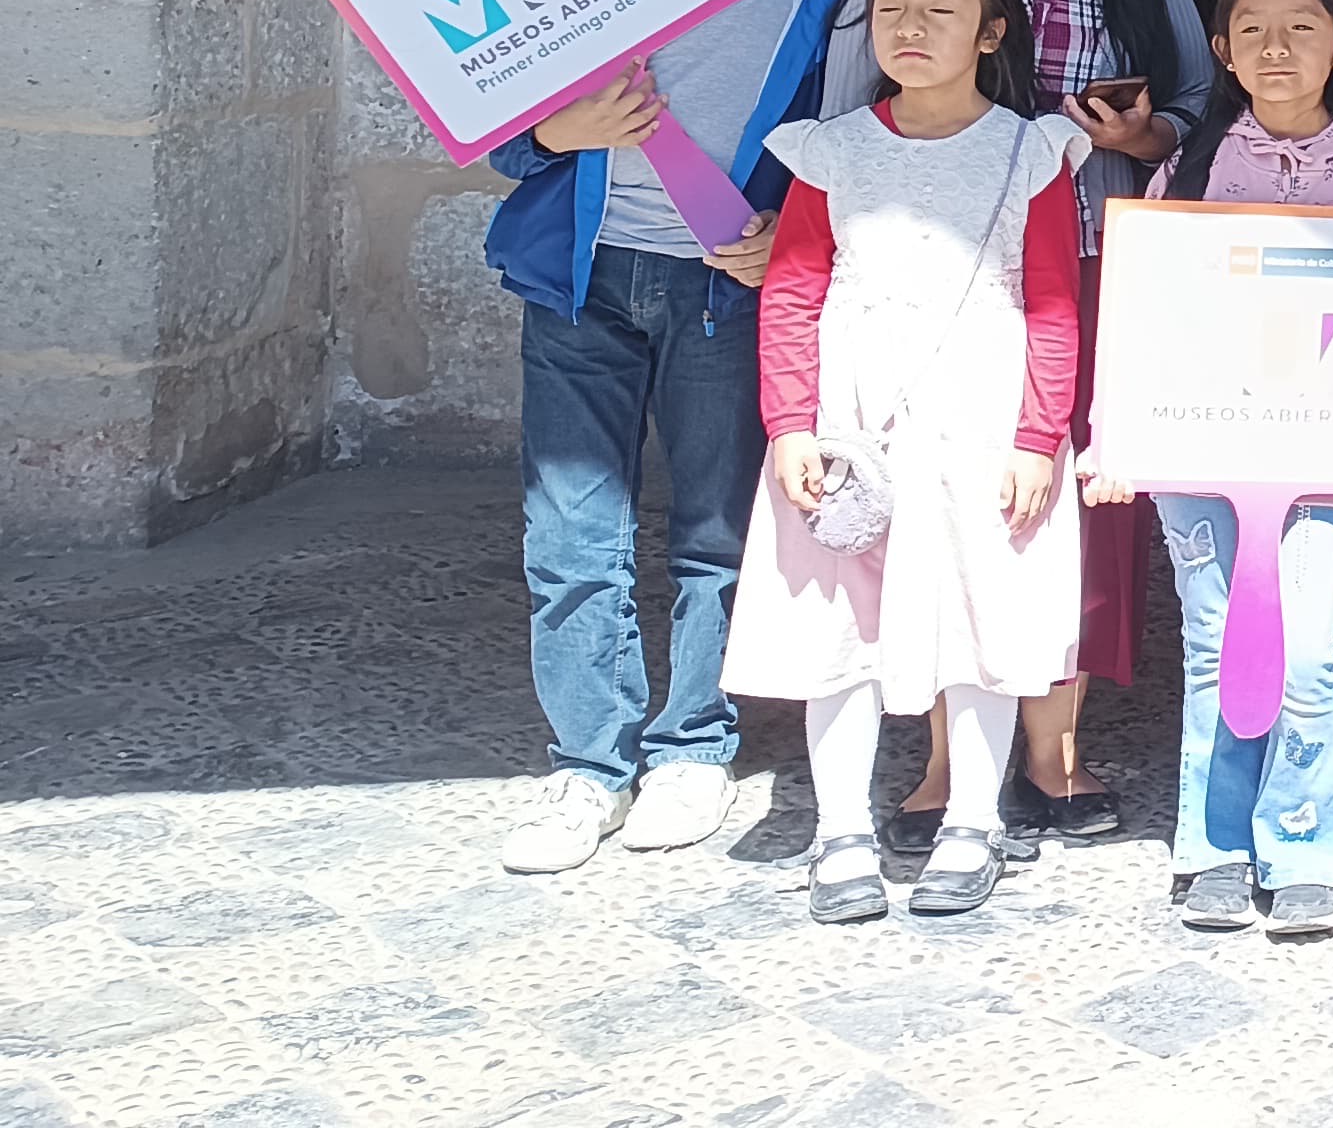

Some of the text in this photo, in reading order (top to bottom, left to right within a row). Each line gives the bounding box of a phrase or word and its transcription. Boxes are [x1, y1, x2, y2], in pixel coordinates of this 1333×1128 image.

[459, 15, 555, 77] MUSEOS
[475, 54, 534, 93] Primer
[537, 10, 612, 59] domingo
[1152, 406, 1250, 421] MUSEOS
